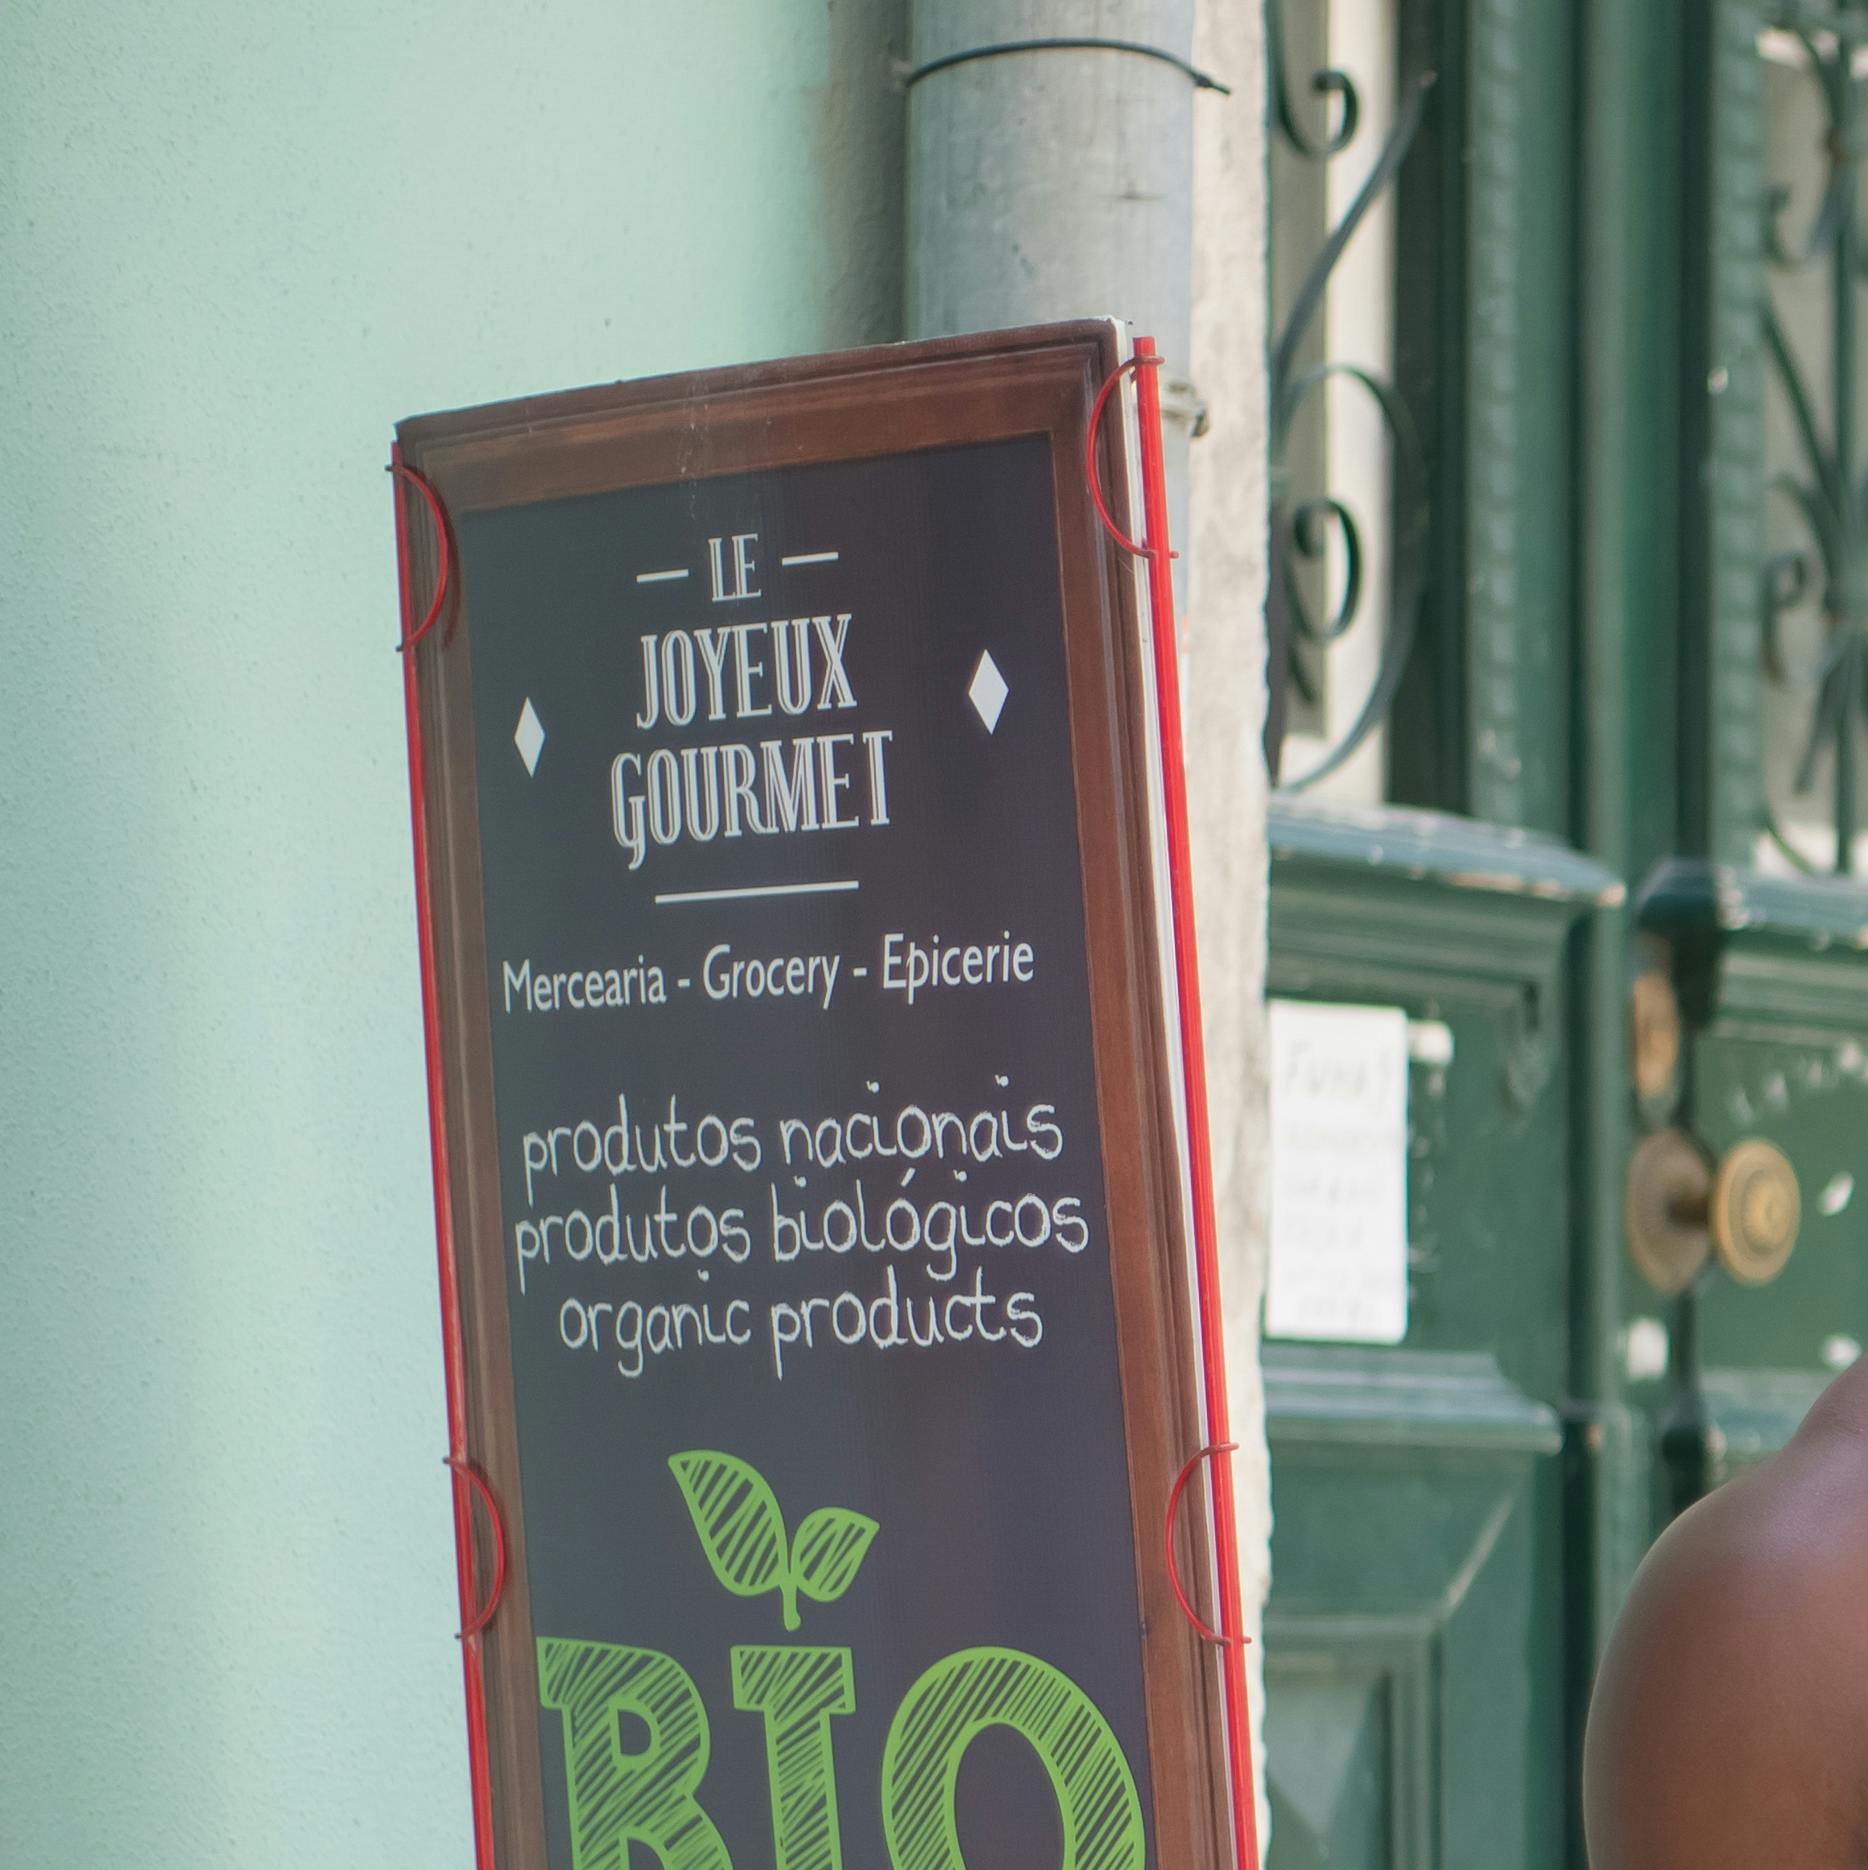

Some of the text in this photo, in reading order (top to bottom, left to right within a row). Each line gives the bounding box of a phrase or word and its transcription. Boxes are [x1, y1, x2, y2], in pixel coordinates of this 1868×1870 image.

[709, 534, 762, 602] LE
[636, 613, 858, 730] JOYEUX
[610, 730, 893, 871] GOURMET
[502, 954, 667, 1013] Mercearia
[702, 943, 840, 1010] Grocery
[882, 930, 1034, 1005] Epicerie
[522, 1075, 1063, 1207] produtos nacionais
[515, 1168, 1089, 1295] produtos biológicos
[559, 1265, 1043, 1381] organic products
